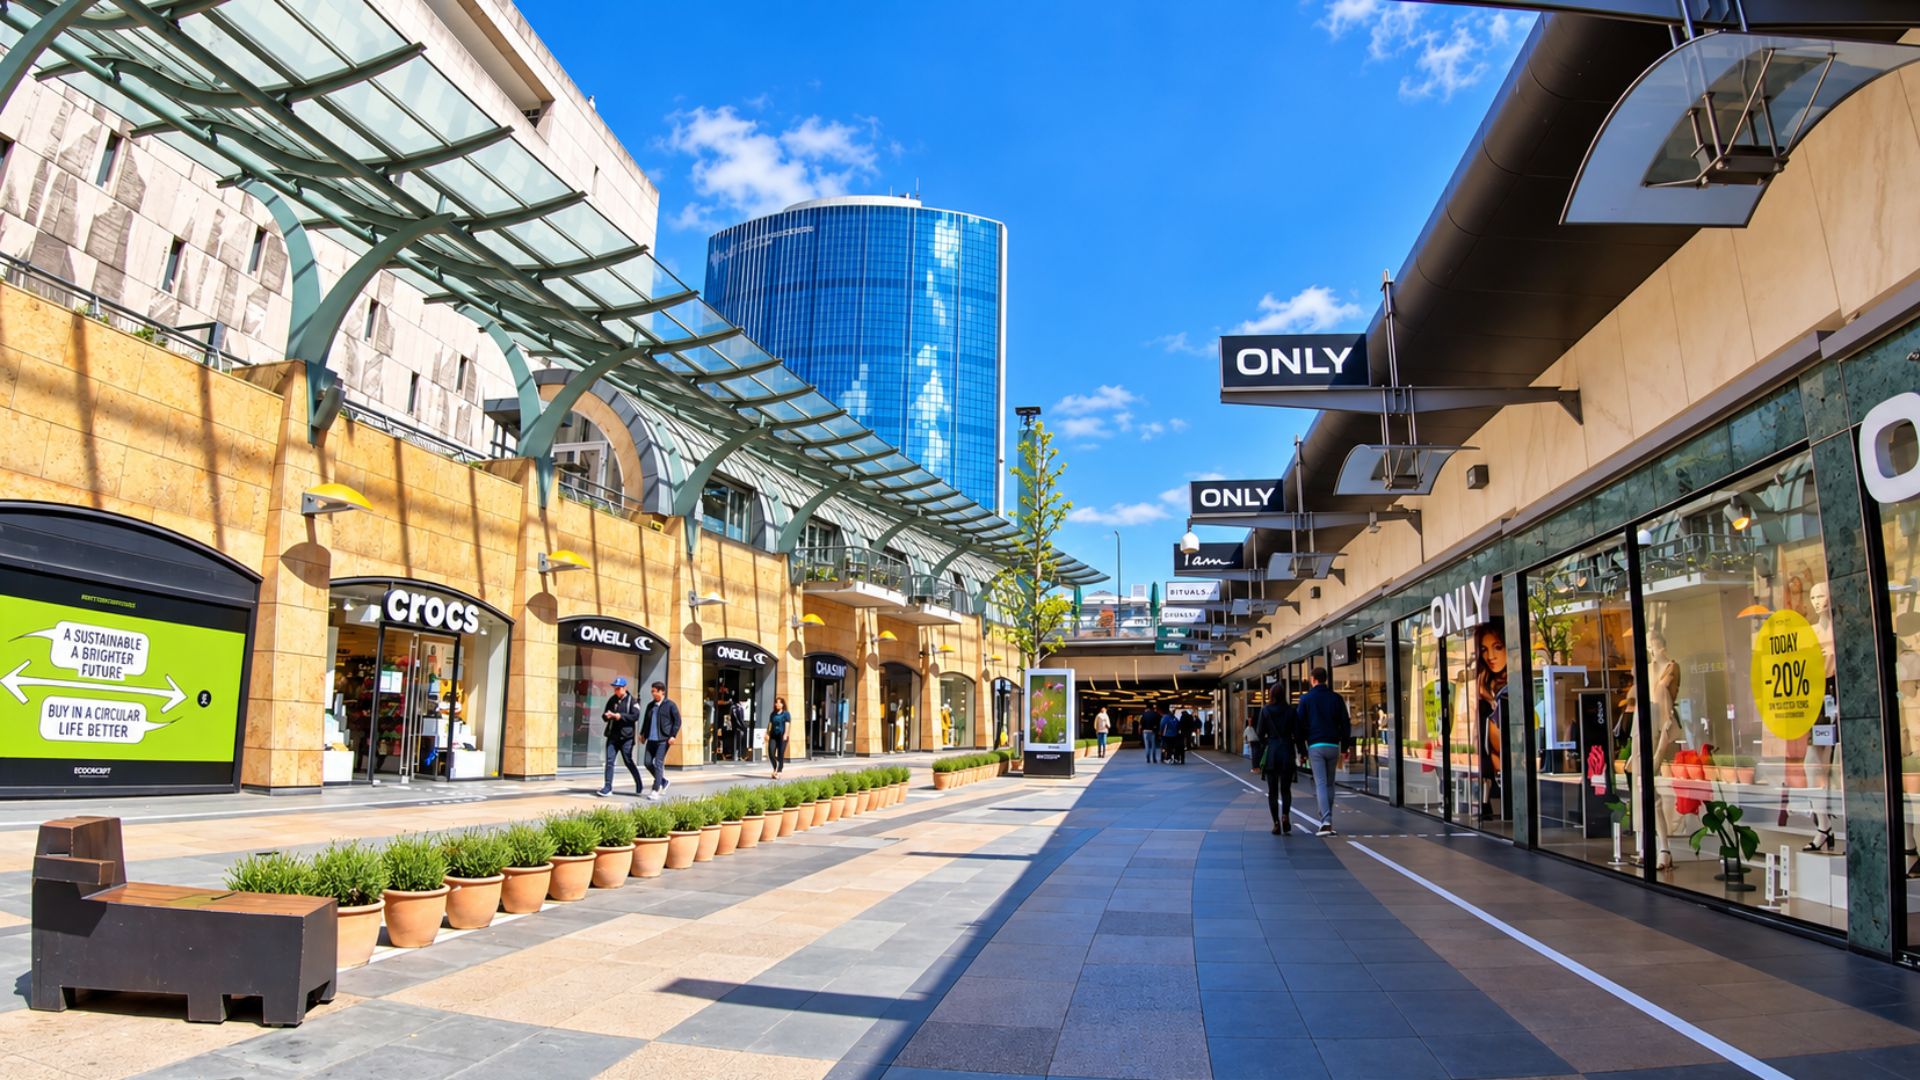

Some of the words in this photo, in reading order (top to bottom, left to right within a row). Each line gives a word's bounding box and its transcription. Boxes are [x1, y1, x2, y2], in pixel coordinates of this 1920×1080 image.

[1236, 347, 1353, 376] ONLY
[1200, 487, 1276, 508] ONLY
[386, 589, 479, 634] crocs
[1431, 575, 1491, 638] ONLY
[63, 628, 72, 641] A
[74, 629, 142, 651] SUSTAINABLE
[581, 625, 631, 648] ONEILL
[1769, 632, 1799, 655] TODAY
[71, 646, 79, 659] A
[82, 647, 134, 666] BRIGHTER
[81, 664, 123, 680] FUTURE
[1765, 659, 1810, 698] -20%
[48, 704, 70, 718] BUY
[72, 705, 83, 719] IN
[84, 706, 93, 719] A
[94, 707, 140, 722] CIRCULAR
[59, 722, 83, 736] LIFE
[87, 723, 128, 738] BETTER
